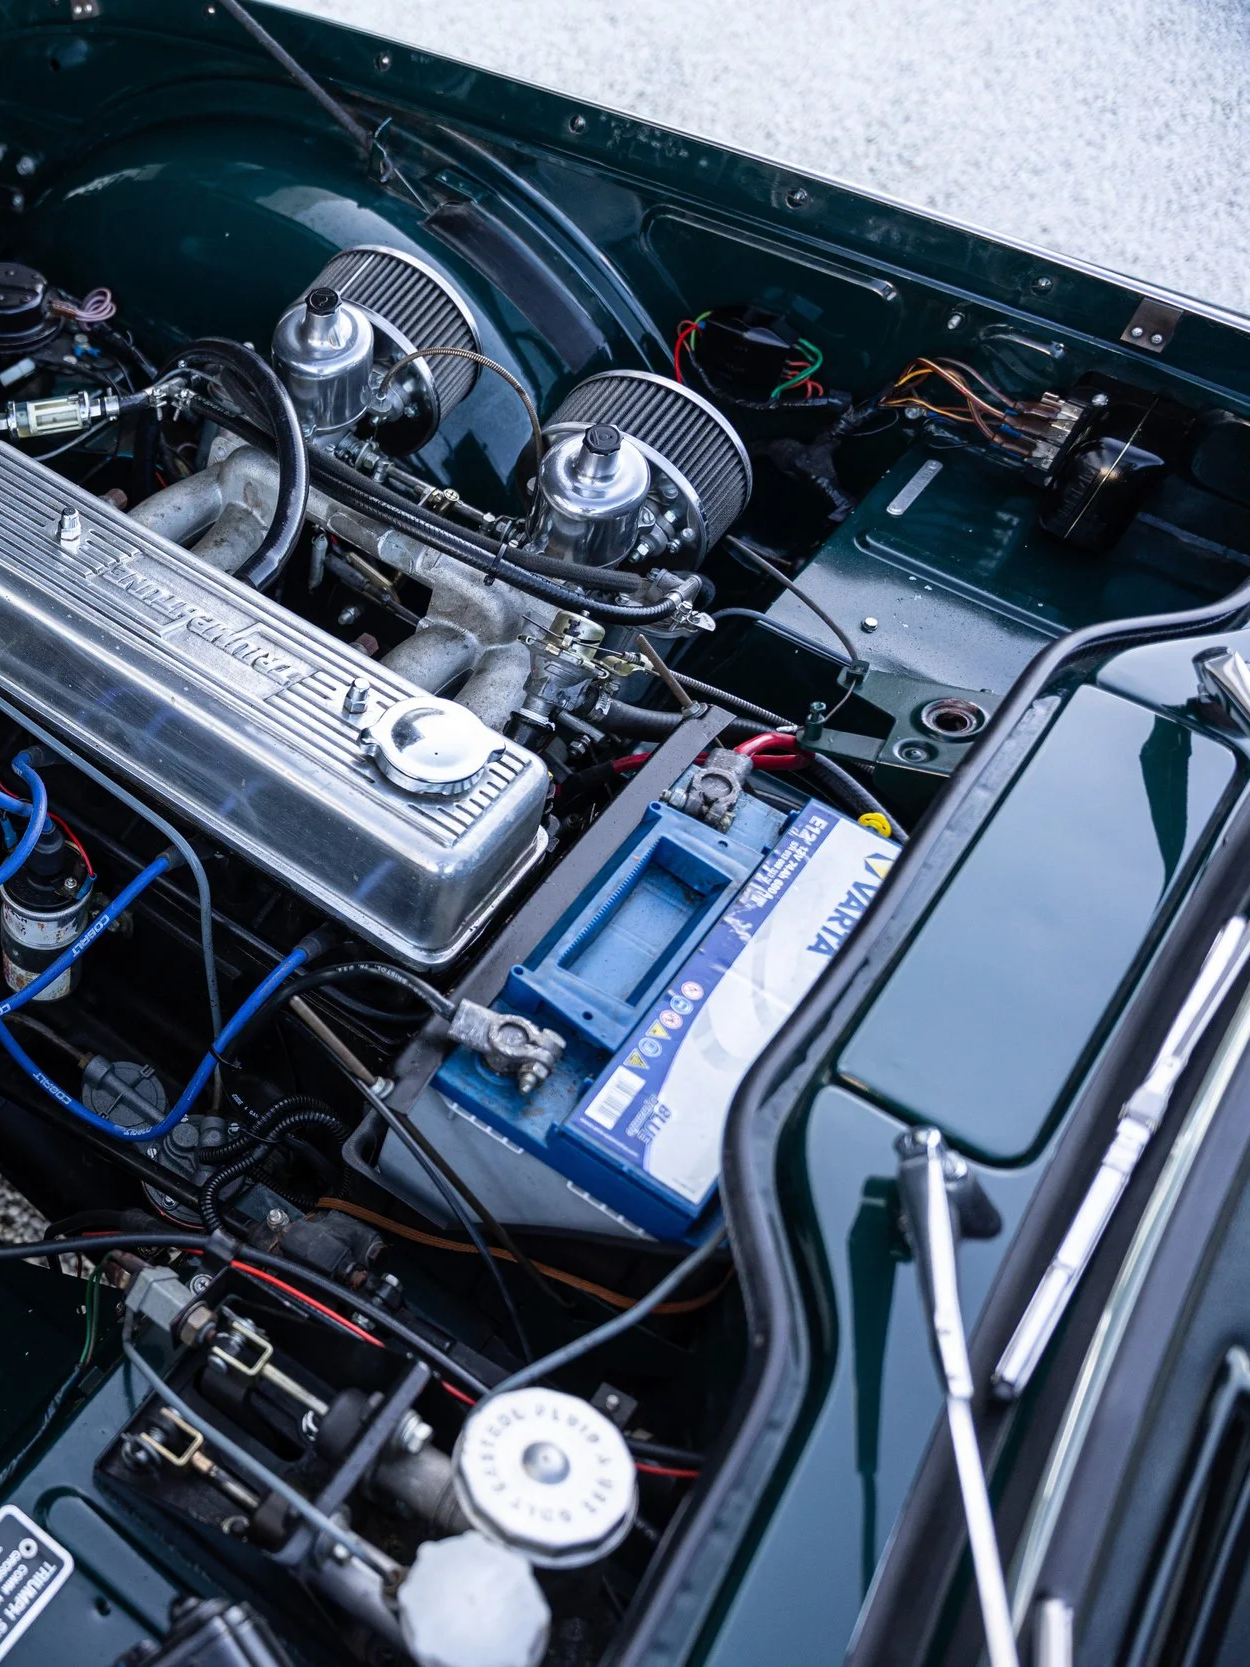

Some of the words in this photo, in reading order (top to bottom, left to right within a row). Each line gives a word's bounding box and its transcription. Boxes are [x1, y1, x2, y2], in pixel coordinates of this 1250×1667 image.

[71, 914, 110, 958] COBALT
[32, 1072, 72, 1105] COBALT
[636, 1104, 671, 1145] BLUE
[1, 1564, 28, 1595] COMM
[4, 1561, 57, 1620] TRIUMPH
